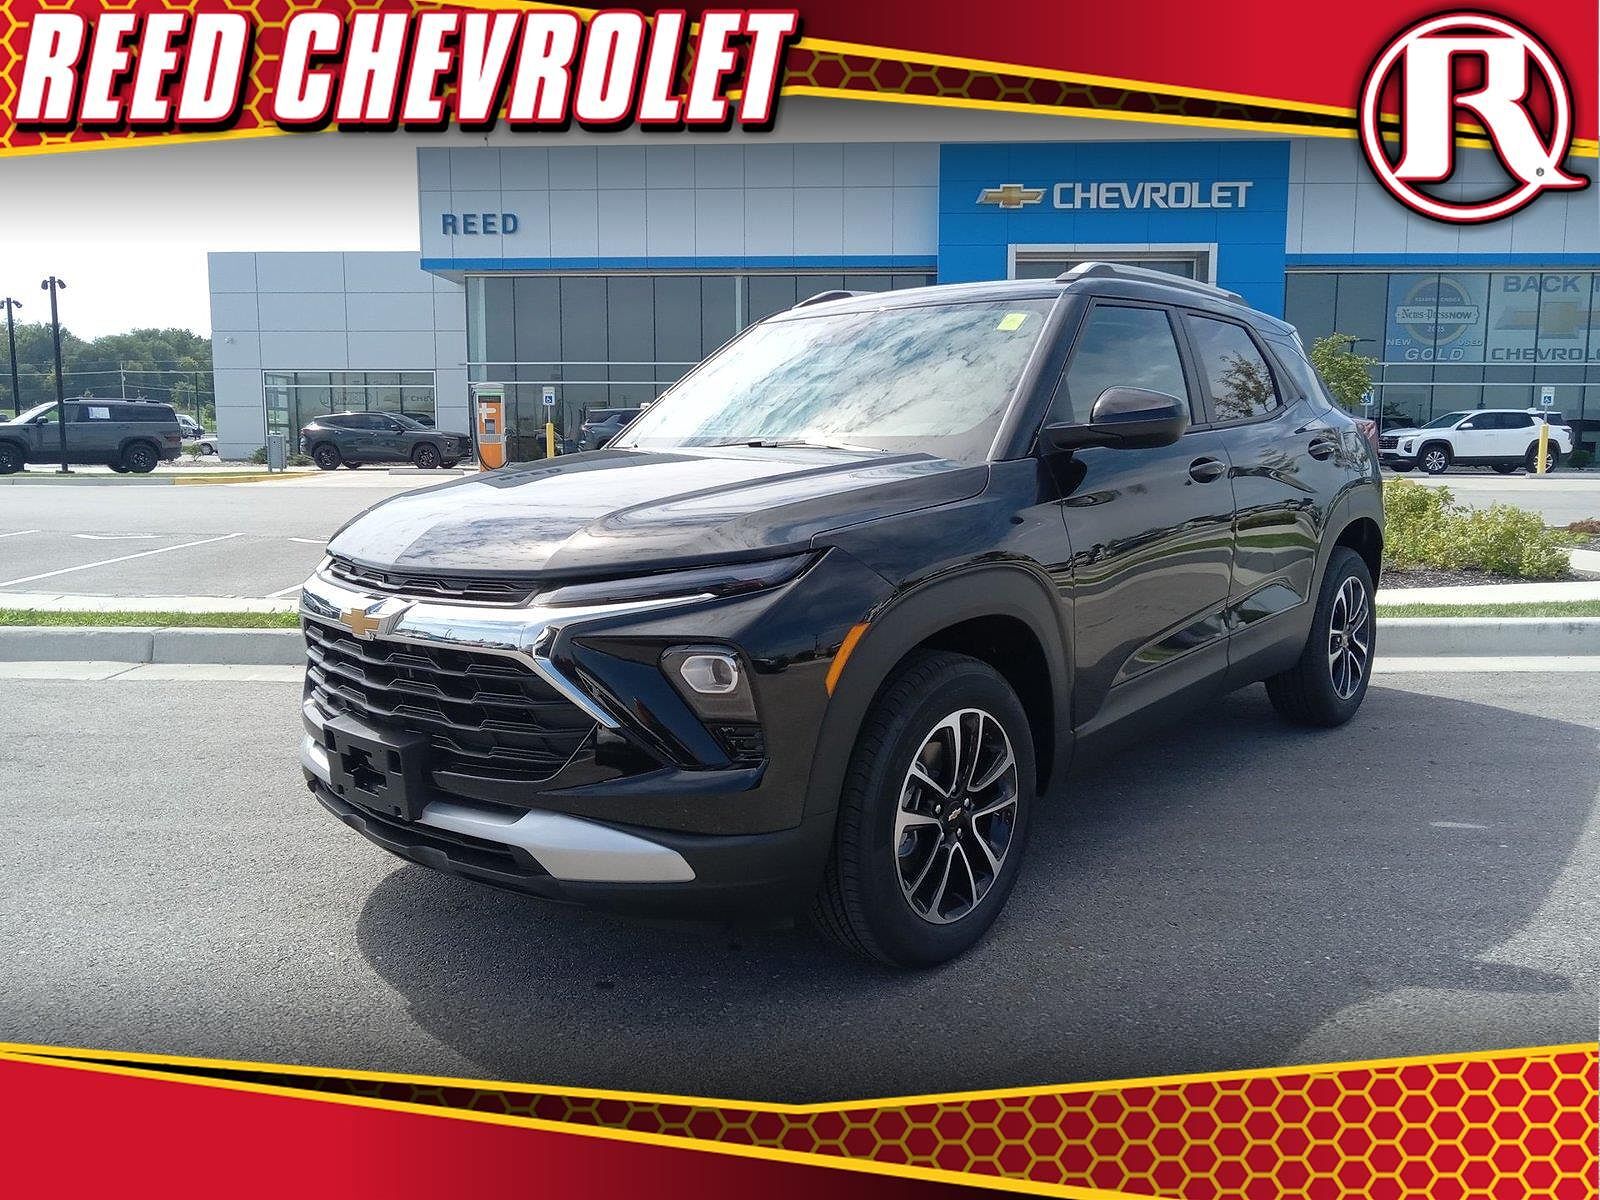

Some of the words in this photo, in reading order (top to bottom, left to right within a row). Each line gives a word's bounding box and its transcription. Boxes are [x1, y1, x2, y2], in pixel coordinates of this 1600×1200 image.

[1052, 181, 1254, 209] CHEVROLET
[441, 213, 519, 235] REED
[1503, 275, 1580, 293] BACK
[1387, 338, 1412, 346] NEW
[1404, 347, 1465, 361] GOLD
